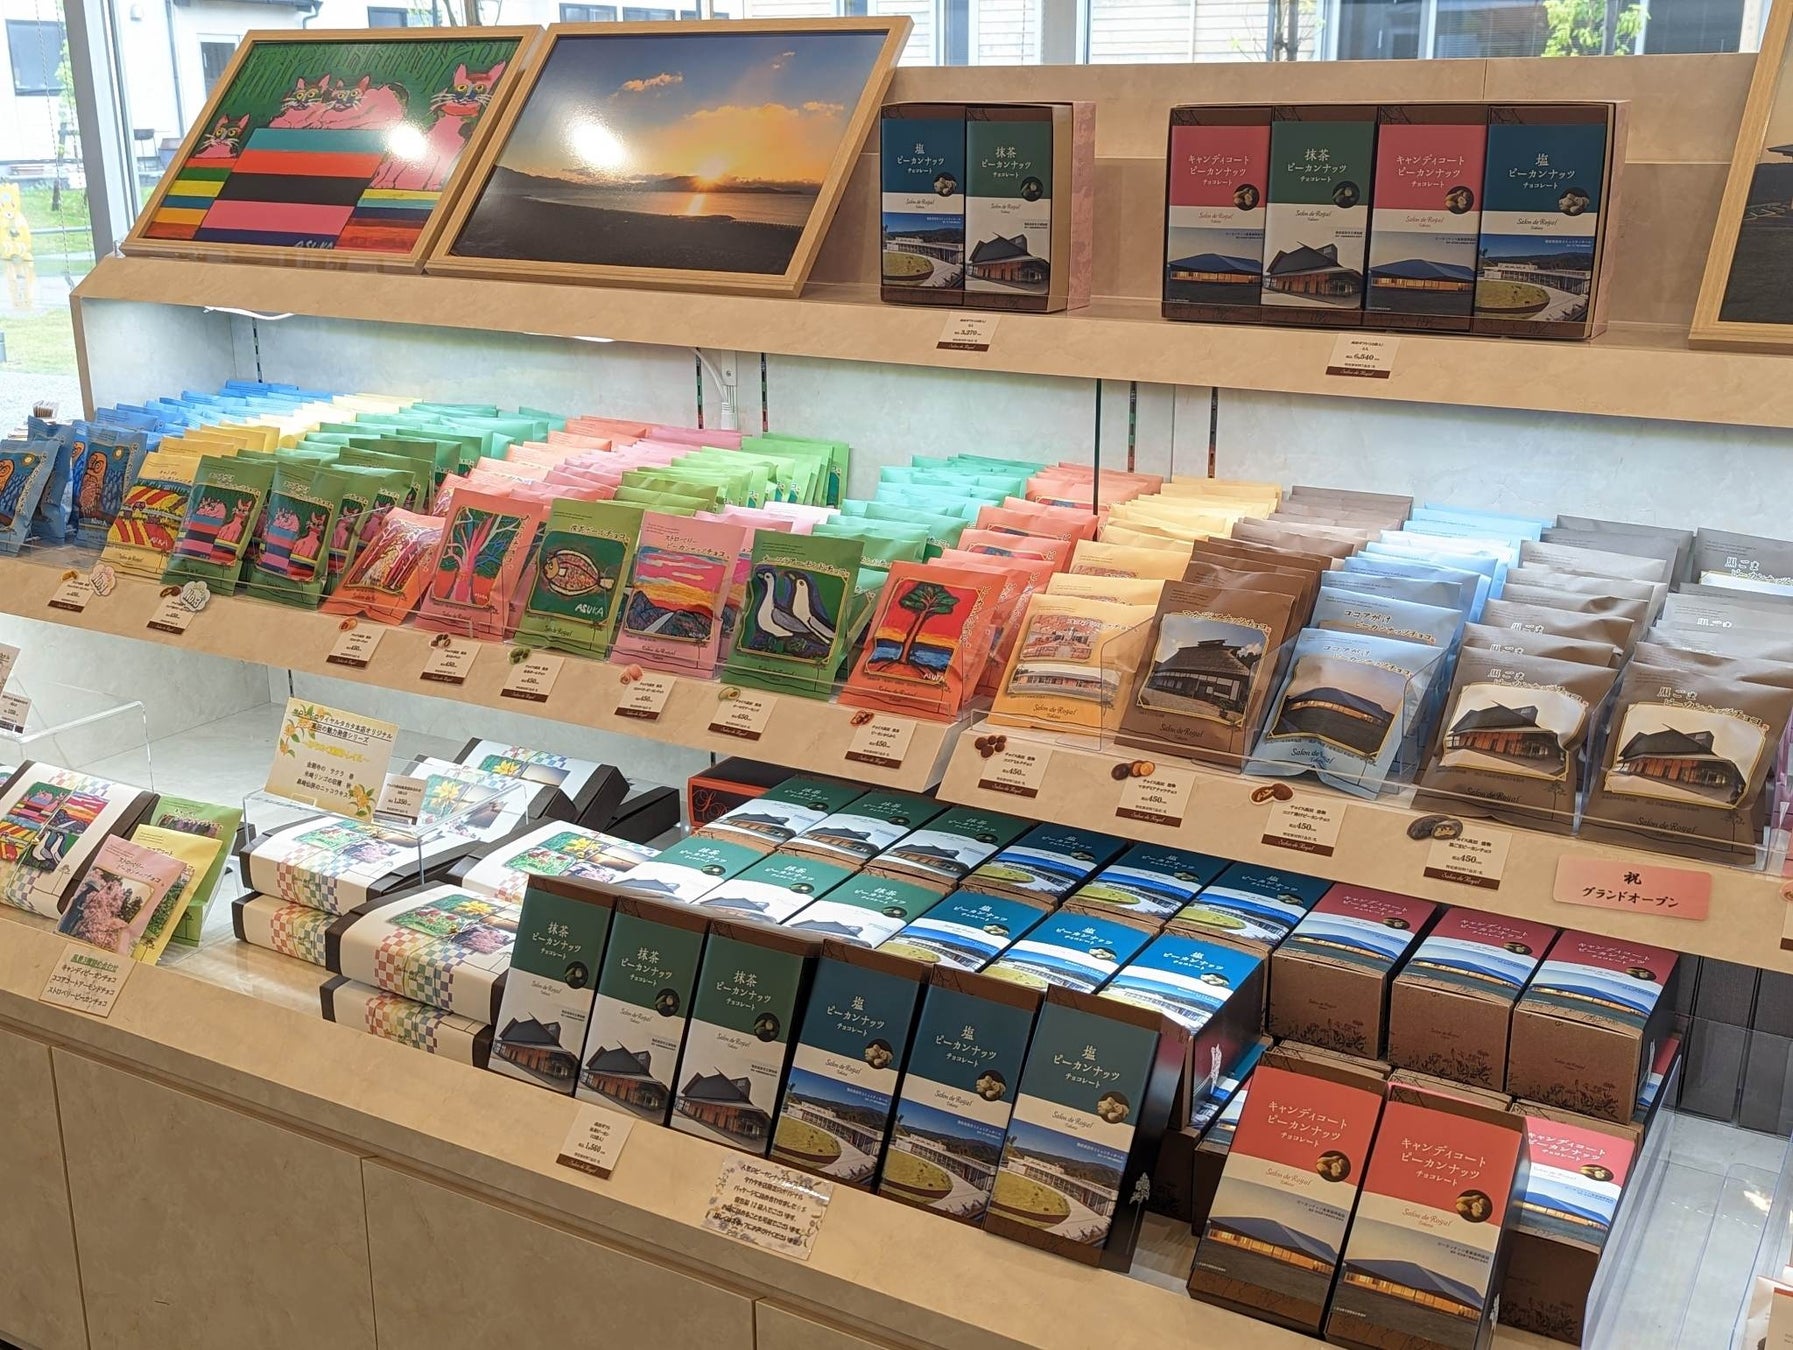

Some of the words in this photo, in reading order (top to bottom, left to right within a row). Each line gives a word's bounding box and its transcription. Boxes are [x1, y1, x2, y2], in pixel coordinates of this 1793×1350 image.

[914, 143, 925, 155] 塩
[995, 146, 1017, 159] 抹茶
[1304, 148, 1330, 162] 抹茶
[897, 157, 945, 166] ピーカンナッツ
[981, 160, 1032, 170] ピーカンナッツ
[1188, 153, 1249, 165] キャンディコート
[1396, 153, 1465, 166] キャンディコート
[1535, 153, 1549, 166] 塩
[1190, 167, 1246, 177] ピーカンナッツ
[1287, 164, 1347, 174] ピーカンナッツ
[1398, 167, 1461, 179] ピーカンナッツ
[1508, 168, 1575, 180] ピーカンナッツ
[1300, 175, 1332, 183] チョコレート
[1411, 180, 1444, 188] チョコレート
[1522, 181, 1558, 190] チョコレート
[575, 603, 604, 617] ASUKA
[1344, 610, 1392, 623] ココアがけ
[1033, 703, 1049, 713] Salon
[1057, 707, 1078, 717] Royal
[1160, 723, 1176, 733] Salon
[1177, 726, 1184, 734] de
[1185, 727, 1204, 739] Royal
[1291, 747, 1310, 757] Salon
[1008, 767, 1022, 776] 450
[1149, 795, 1162, 804] 450
[1296, 822, 1312, 832] 450
[1636, 816, 1658, 828] Salon
[1658, 819, 1669, 829] de
[1669, 820, 1697, 834] Royal
[1461, 854, 1477, 864] 450
[1623, 871, 1642, 885] 祝
[1582, 887, 1679, 908] グランドオープン
[548, 922, 569, 938] 抹茶
[532, 932, 582, 953] ピーカンナッツ
[540, 948, 567, 961] チョコレート
[637, 947, 660, 964] 抹茶
[621, 958, 673, 979] ピーカンナッツ
[629, 973, 658, 987] チョコレート
[733, 970, 758, 988] 抹茶
[716, 981, 772, 1003] ピーカンナッツ
[726, 998, 756, 1011] チョコレート
[851, 996, 865, 1011] 塩
[827, 1005, 885, 1029] ピーカンナッツ
[837, 1022, 868, 1037] チョコレート
[960, 1025, 975, 1041] 塩
[936, 1034, 997, 1061] ピーカンナッツ
[1081, 1045, 1097, 1061] 塩
[946, 1052, 979, 1068] チョコレート
[1053, 1054, 1120, 1081] ピーカンナッツ
[1065, 1072, 1101, 1089] チョコレート
[1052, 1110, 1067, 1121] Salon
[1075, 1117, 1094, 1129] Royal
[1268, 1101, 1348, 1130] キャンディコート
[1267, 1114, 1341, 1141] ピーカンナッツ
[1281, 1132, 1319, 1148] チョコレート
[1528, 1132, 1606, 1156] キャンディコート
[1401, 1138, 1486, 1168] キャンディコート
[1528, 1138, 1601, 1160] ピーカンナッツ
[1401, 1152, 1480, 1180] ピーカンナッツ
[1266, 1167, 1282, 1179] Salon
[1291, 1173, 1313, 1187] Royal
[1415, 1170, 1458, 1187] チョコレート
[1402, 1208, 1420, 1220] Salon
[1421, 1212, 1430, 1221] de
[1430, 1213, 1454, 1229] Royal
